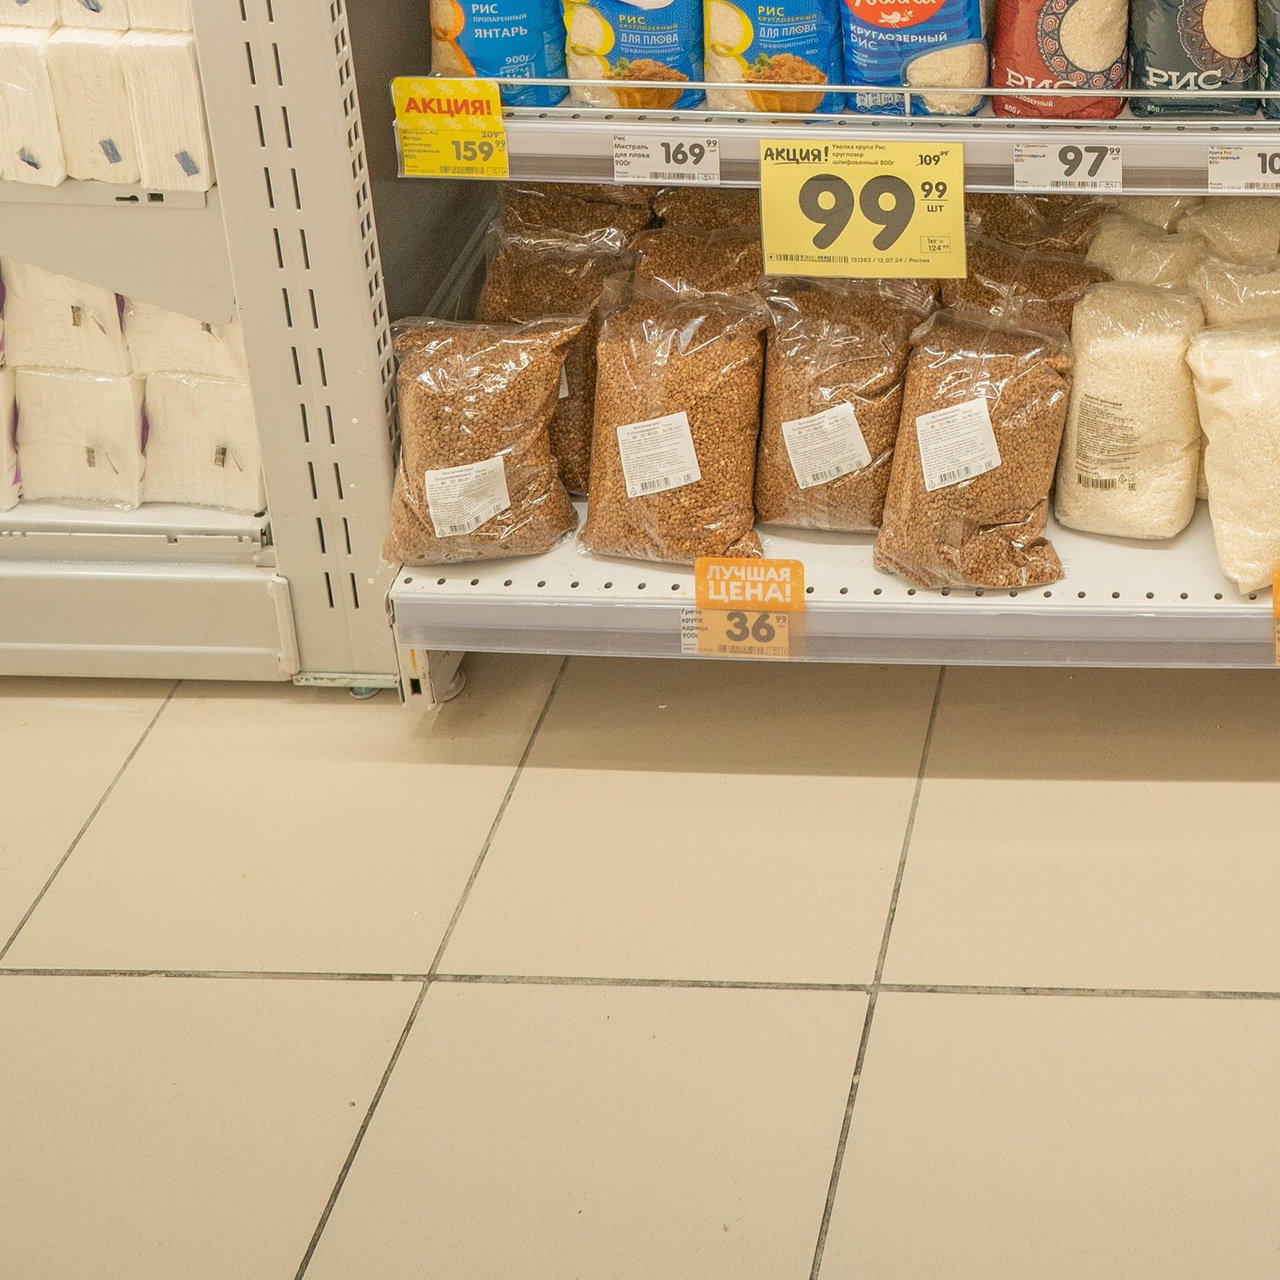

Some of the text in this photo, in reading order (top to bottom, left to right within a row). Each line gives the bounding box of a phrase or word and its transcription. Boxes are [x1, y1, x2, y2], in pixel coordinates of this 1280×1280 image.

[474, 25, 528, 39] ЯНТАРЬ
[850, 23, 948, 43] КРУГЛОЗЕРНЫЙ
[661, 142, 707, 164] 169
[1058, 146, 1109, 177] 97
[798, 173, 916, 251] 99
[707, 564, 791, 582] ЛУЧШАЯ
[708, 580, 791, 602] ЦЕНА!
[725, 612, 777, 642] 36
